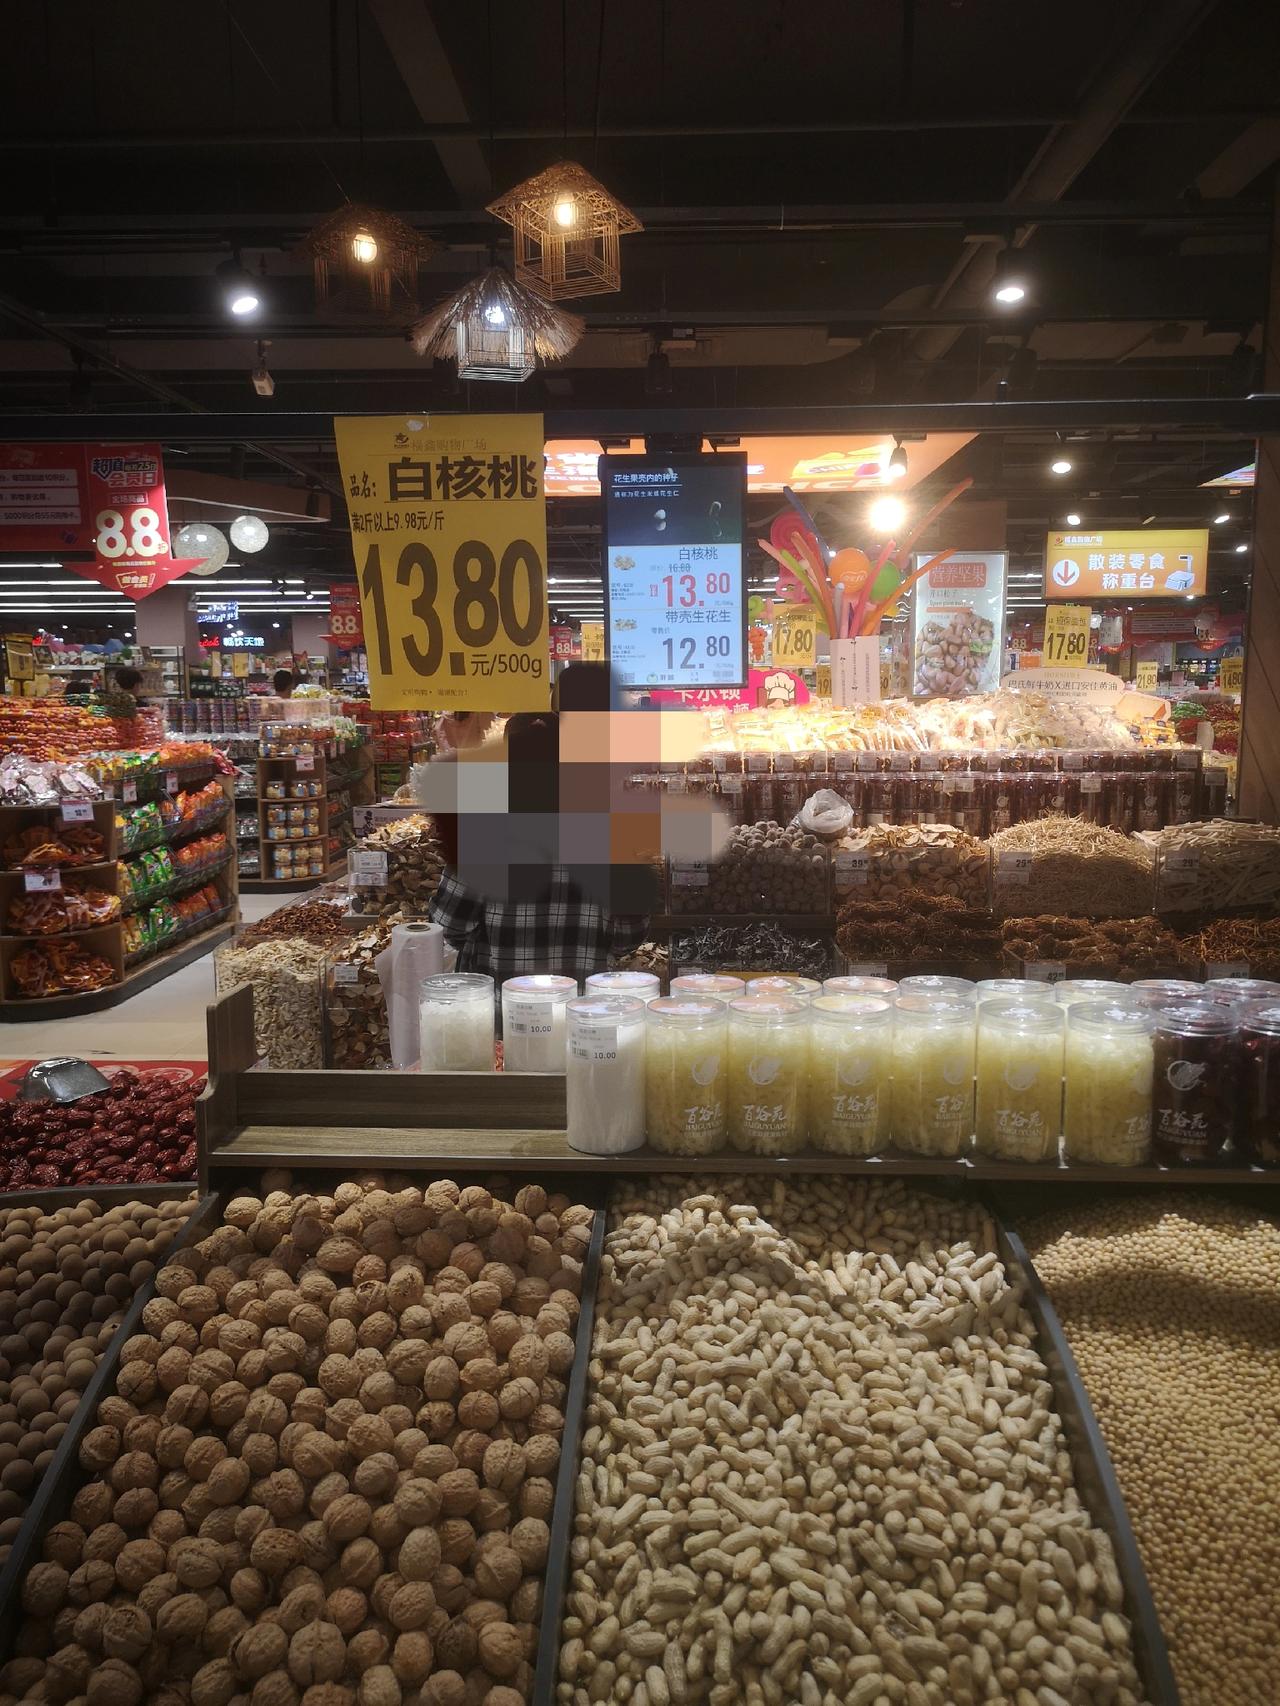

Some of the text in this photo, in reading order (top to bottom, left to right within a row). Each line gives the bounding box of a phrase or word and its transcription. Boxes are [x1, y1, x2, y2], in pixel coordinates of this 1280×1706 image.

[108, 472, 157, 487] 会员日
[388, 455, 537, 501] 白核桃
[96, 508, 161, 558] 8.8
[679, 547, 719, 560] 白核桃
[1088, 552, 1165, 570] 散装零食
[662, 572, 731, 608] 13.80
[1102, 572, 1155, 589] 称重台
[361, 538, 544, 677] 13.80
[666, 609, 731, 623] 带壳生花生
[662, 635, 731, 669] 12.80
[775, 629, 813, 655] 17.80
[1047, 633, 1086, 660] 17.80
[470, 653, 543, 679] 元/500g
[530, 1025, 552, 1033] 10.00
